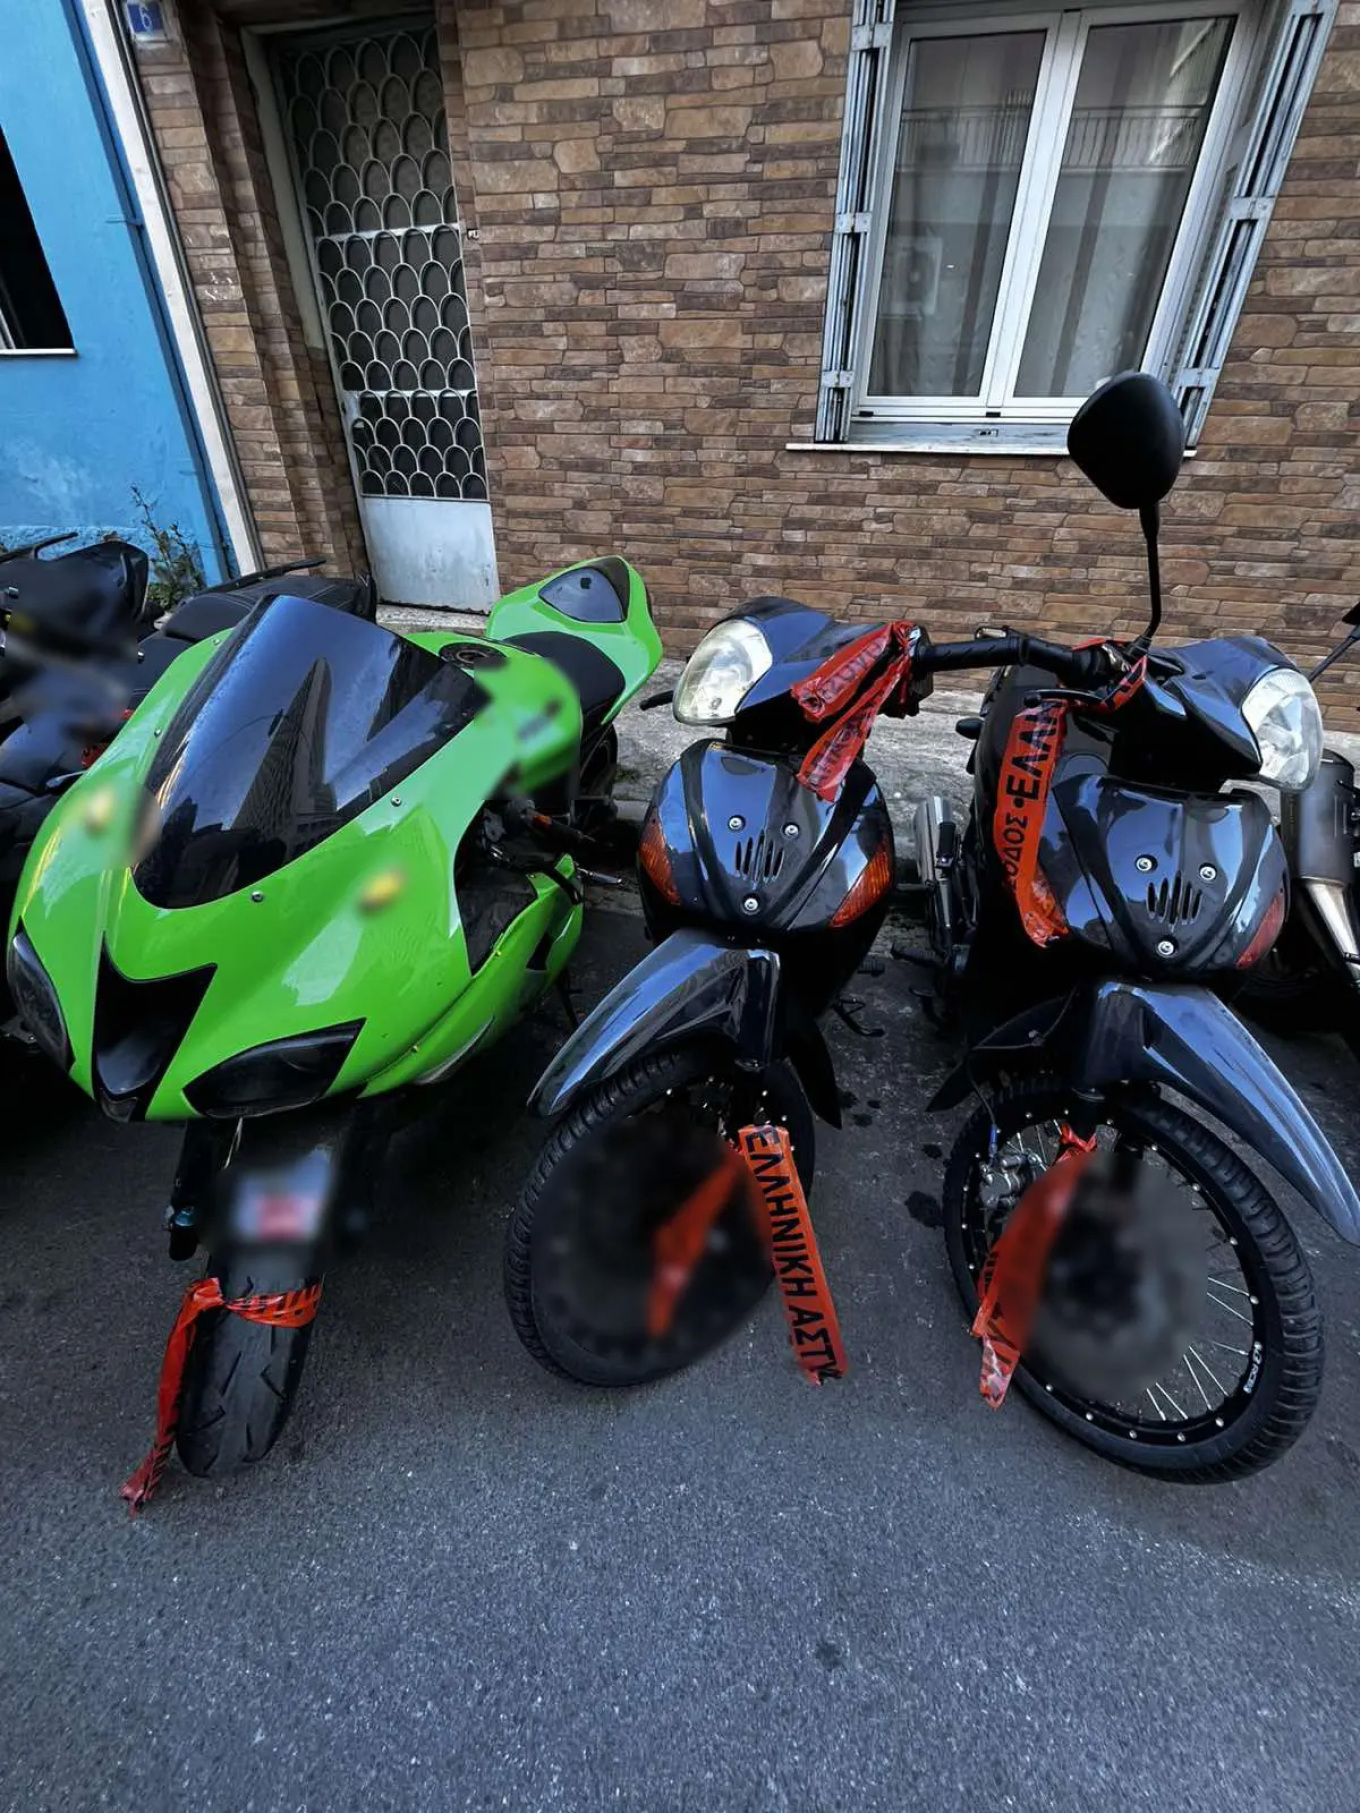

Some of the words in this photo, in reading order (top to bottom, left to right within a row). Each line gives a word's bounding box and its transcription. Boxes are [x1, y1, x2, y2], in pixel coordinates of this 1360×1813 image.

[138, 5, 154, 29] 6
[1001, 812, 1028, 878] ΟΔΟΣ
[746, 1130, 818, 1296] ΕΛΛΗΝΙΚΗ
